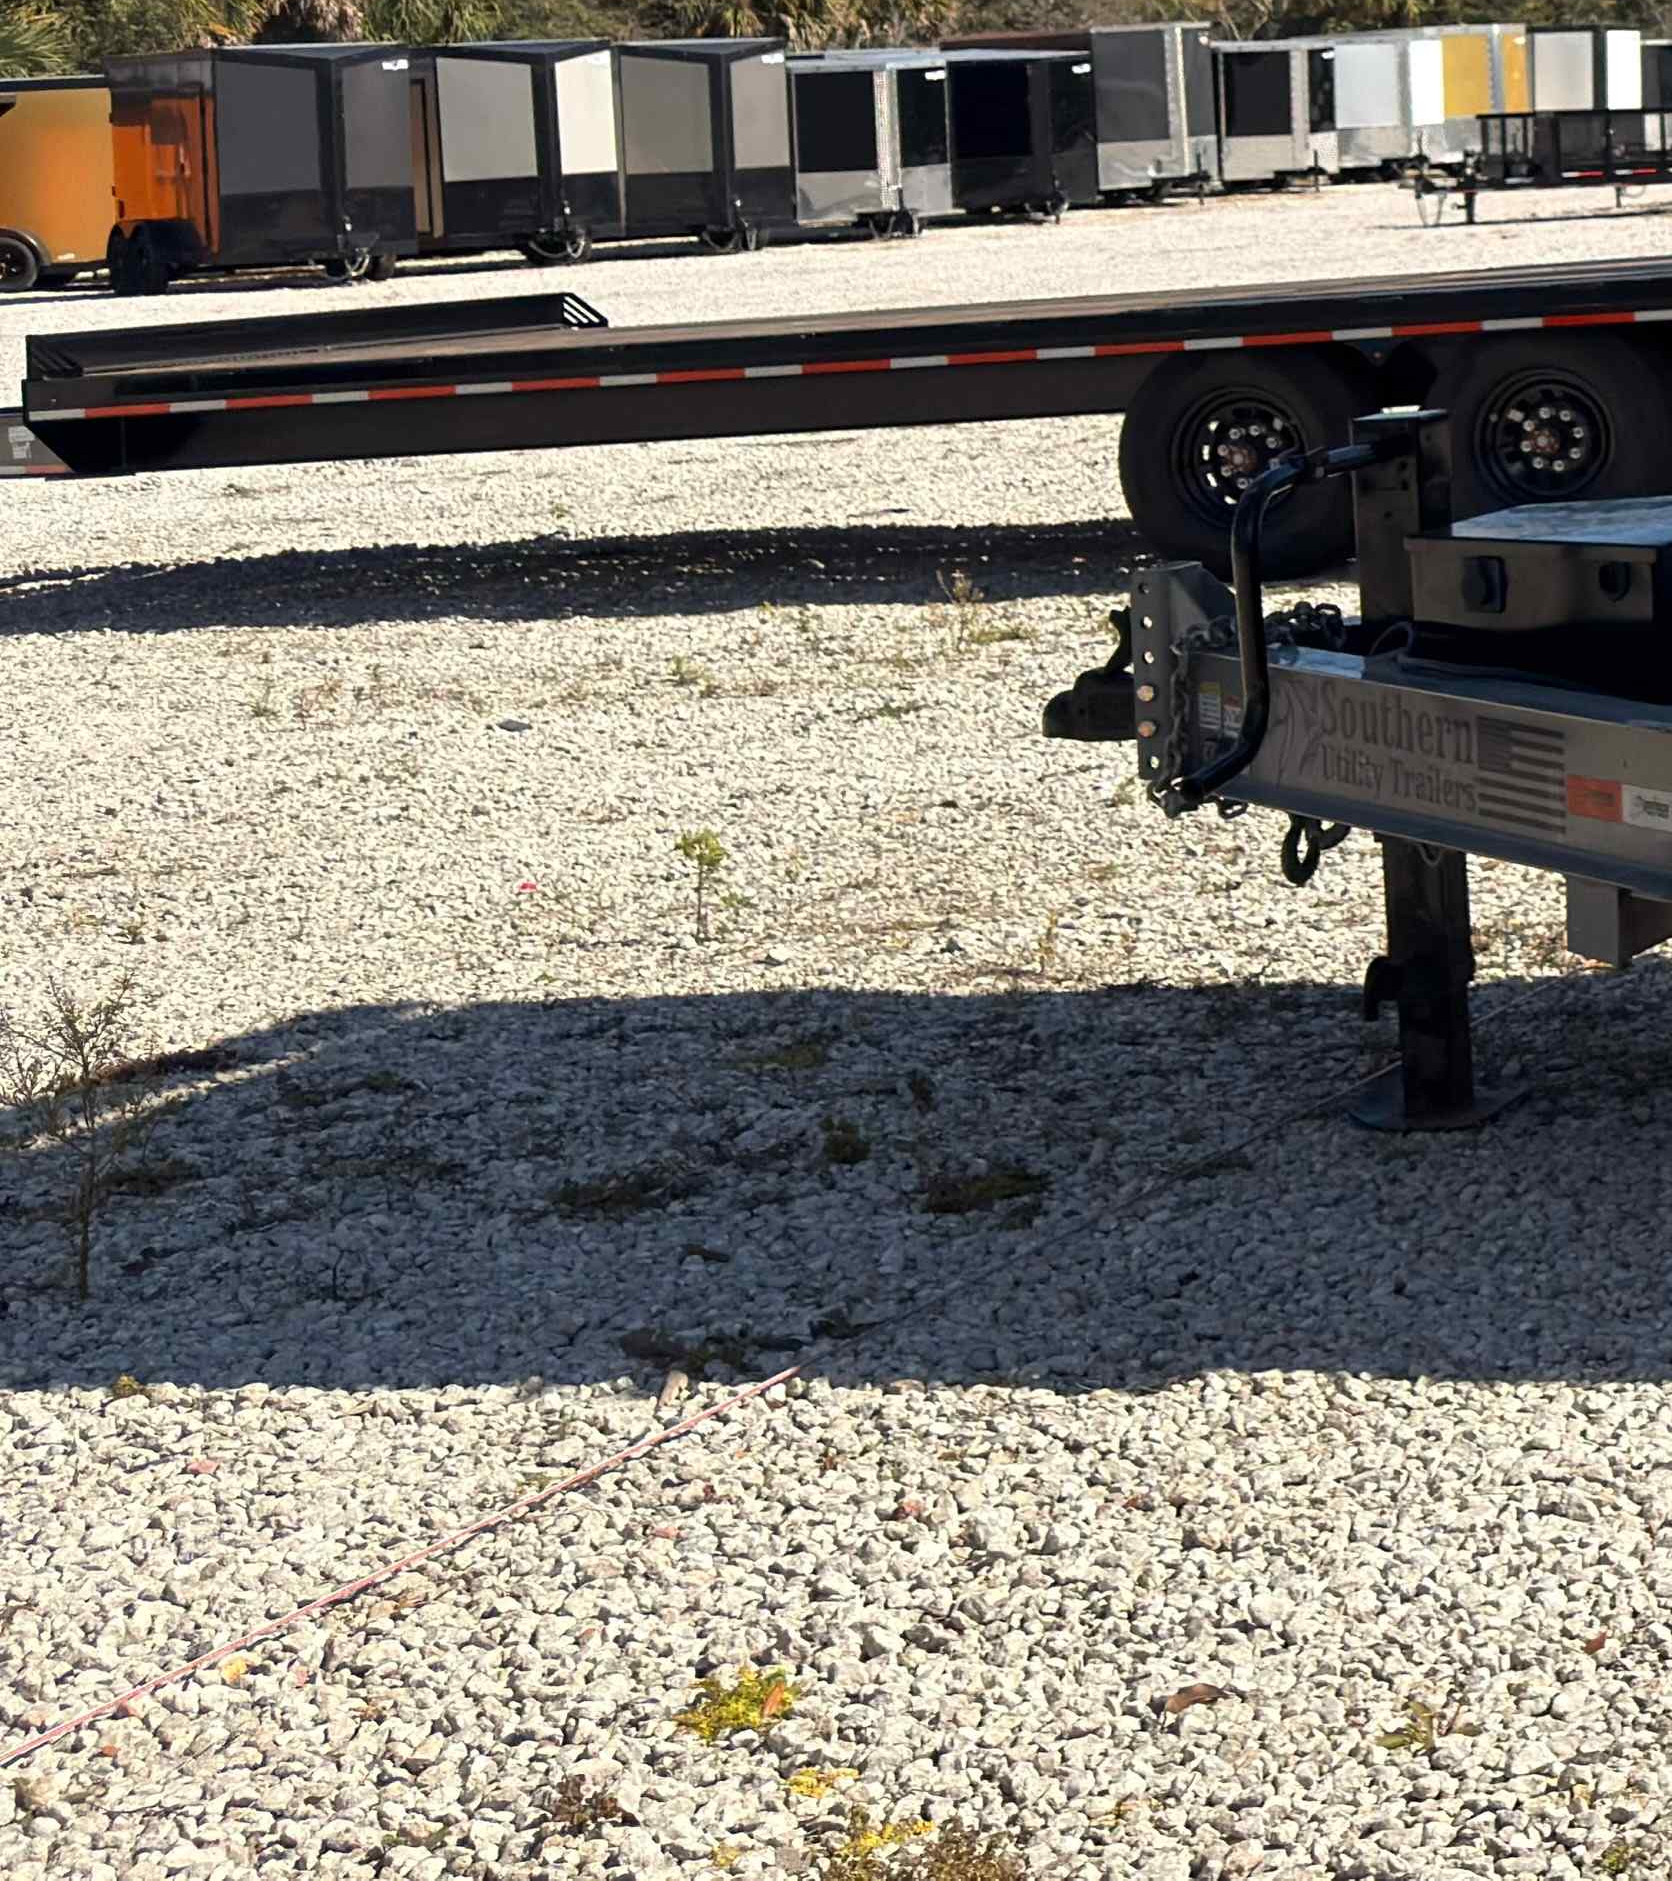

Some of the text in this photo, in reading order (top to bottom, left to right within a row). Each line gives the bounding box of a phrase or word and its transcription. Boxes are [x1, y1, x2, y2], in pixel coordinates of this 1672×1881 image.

[1321, 680, 1473, 764] Southern
[1321, 743, 1477, 811] Utility Trailers
